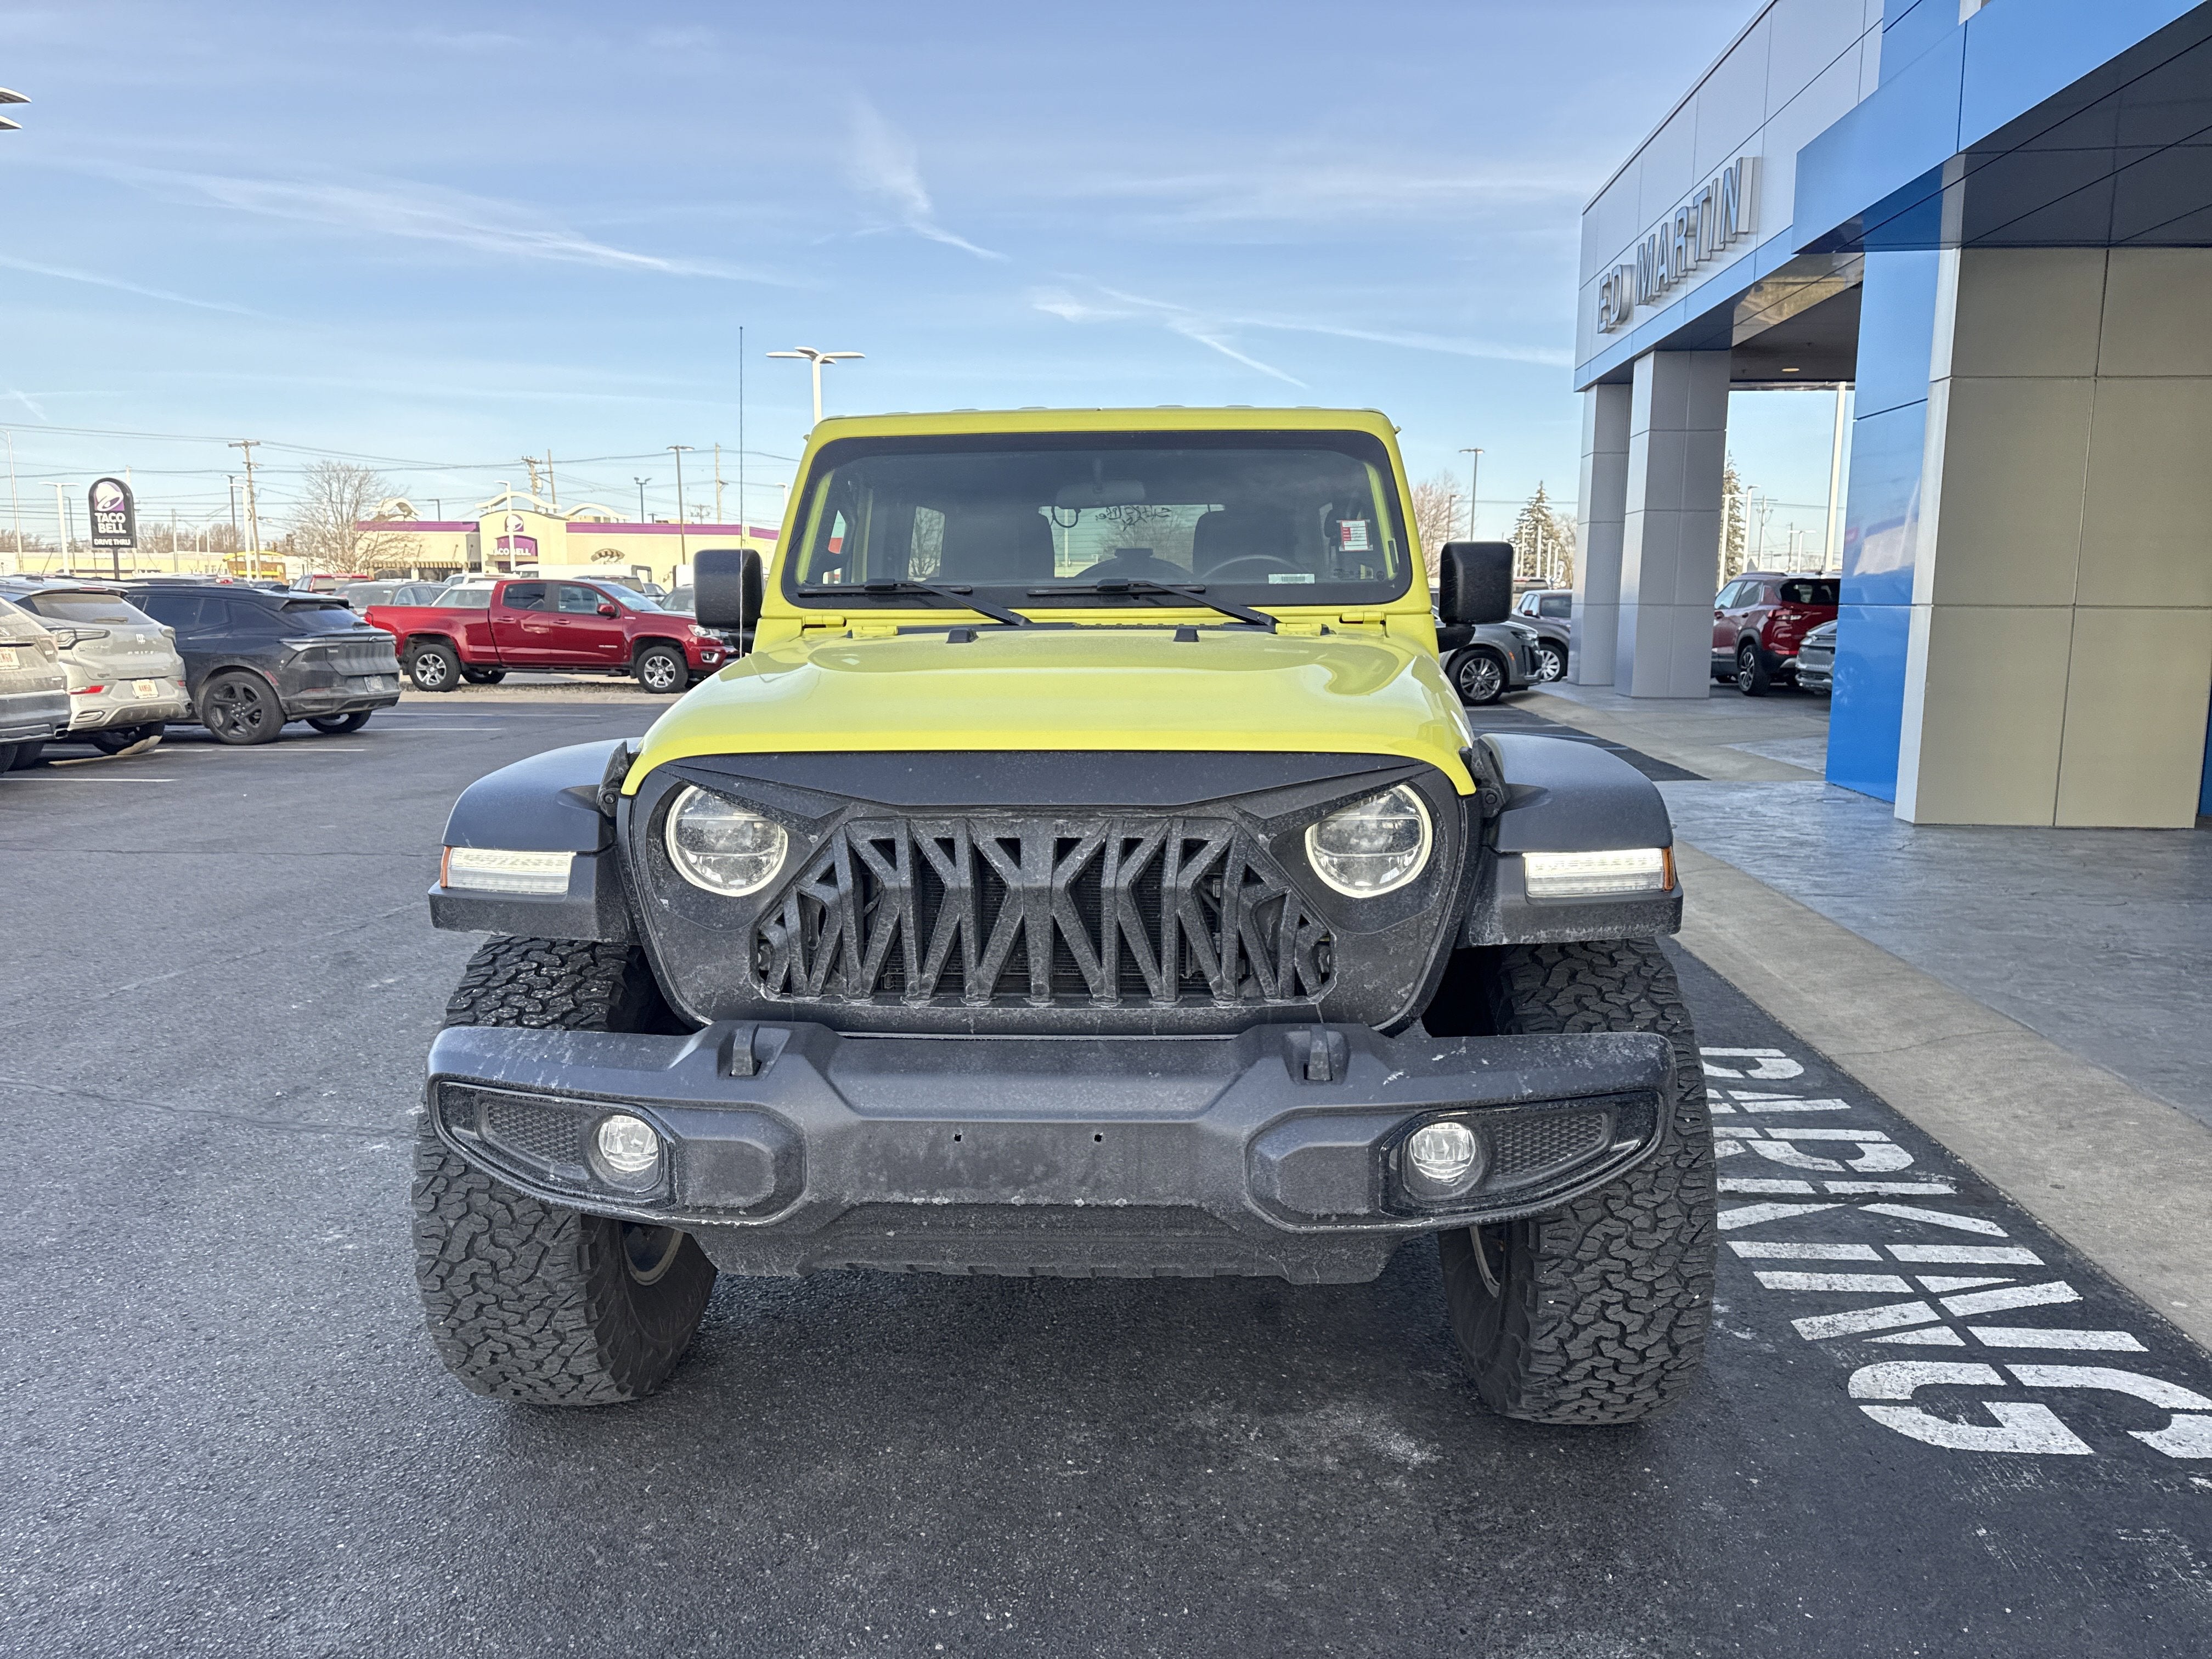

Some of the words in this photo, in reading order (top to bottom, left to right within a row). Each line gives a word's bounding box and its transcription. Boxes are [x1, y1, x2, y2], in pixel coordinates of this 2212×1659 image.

[1597, 264, 1633, 334] ED
[1635, 156, 1755, 307] MARTIN
[94, 512, 126, 523] TACO
[98, 522, 127, 534] BELL
[492, 548, 510, 556] ACO
[514, 548, 532, 556] ELL
